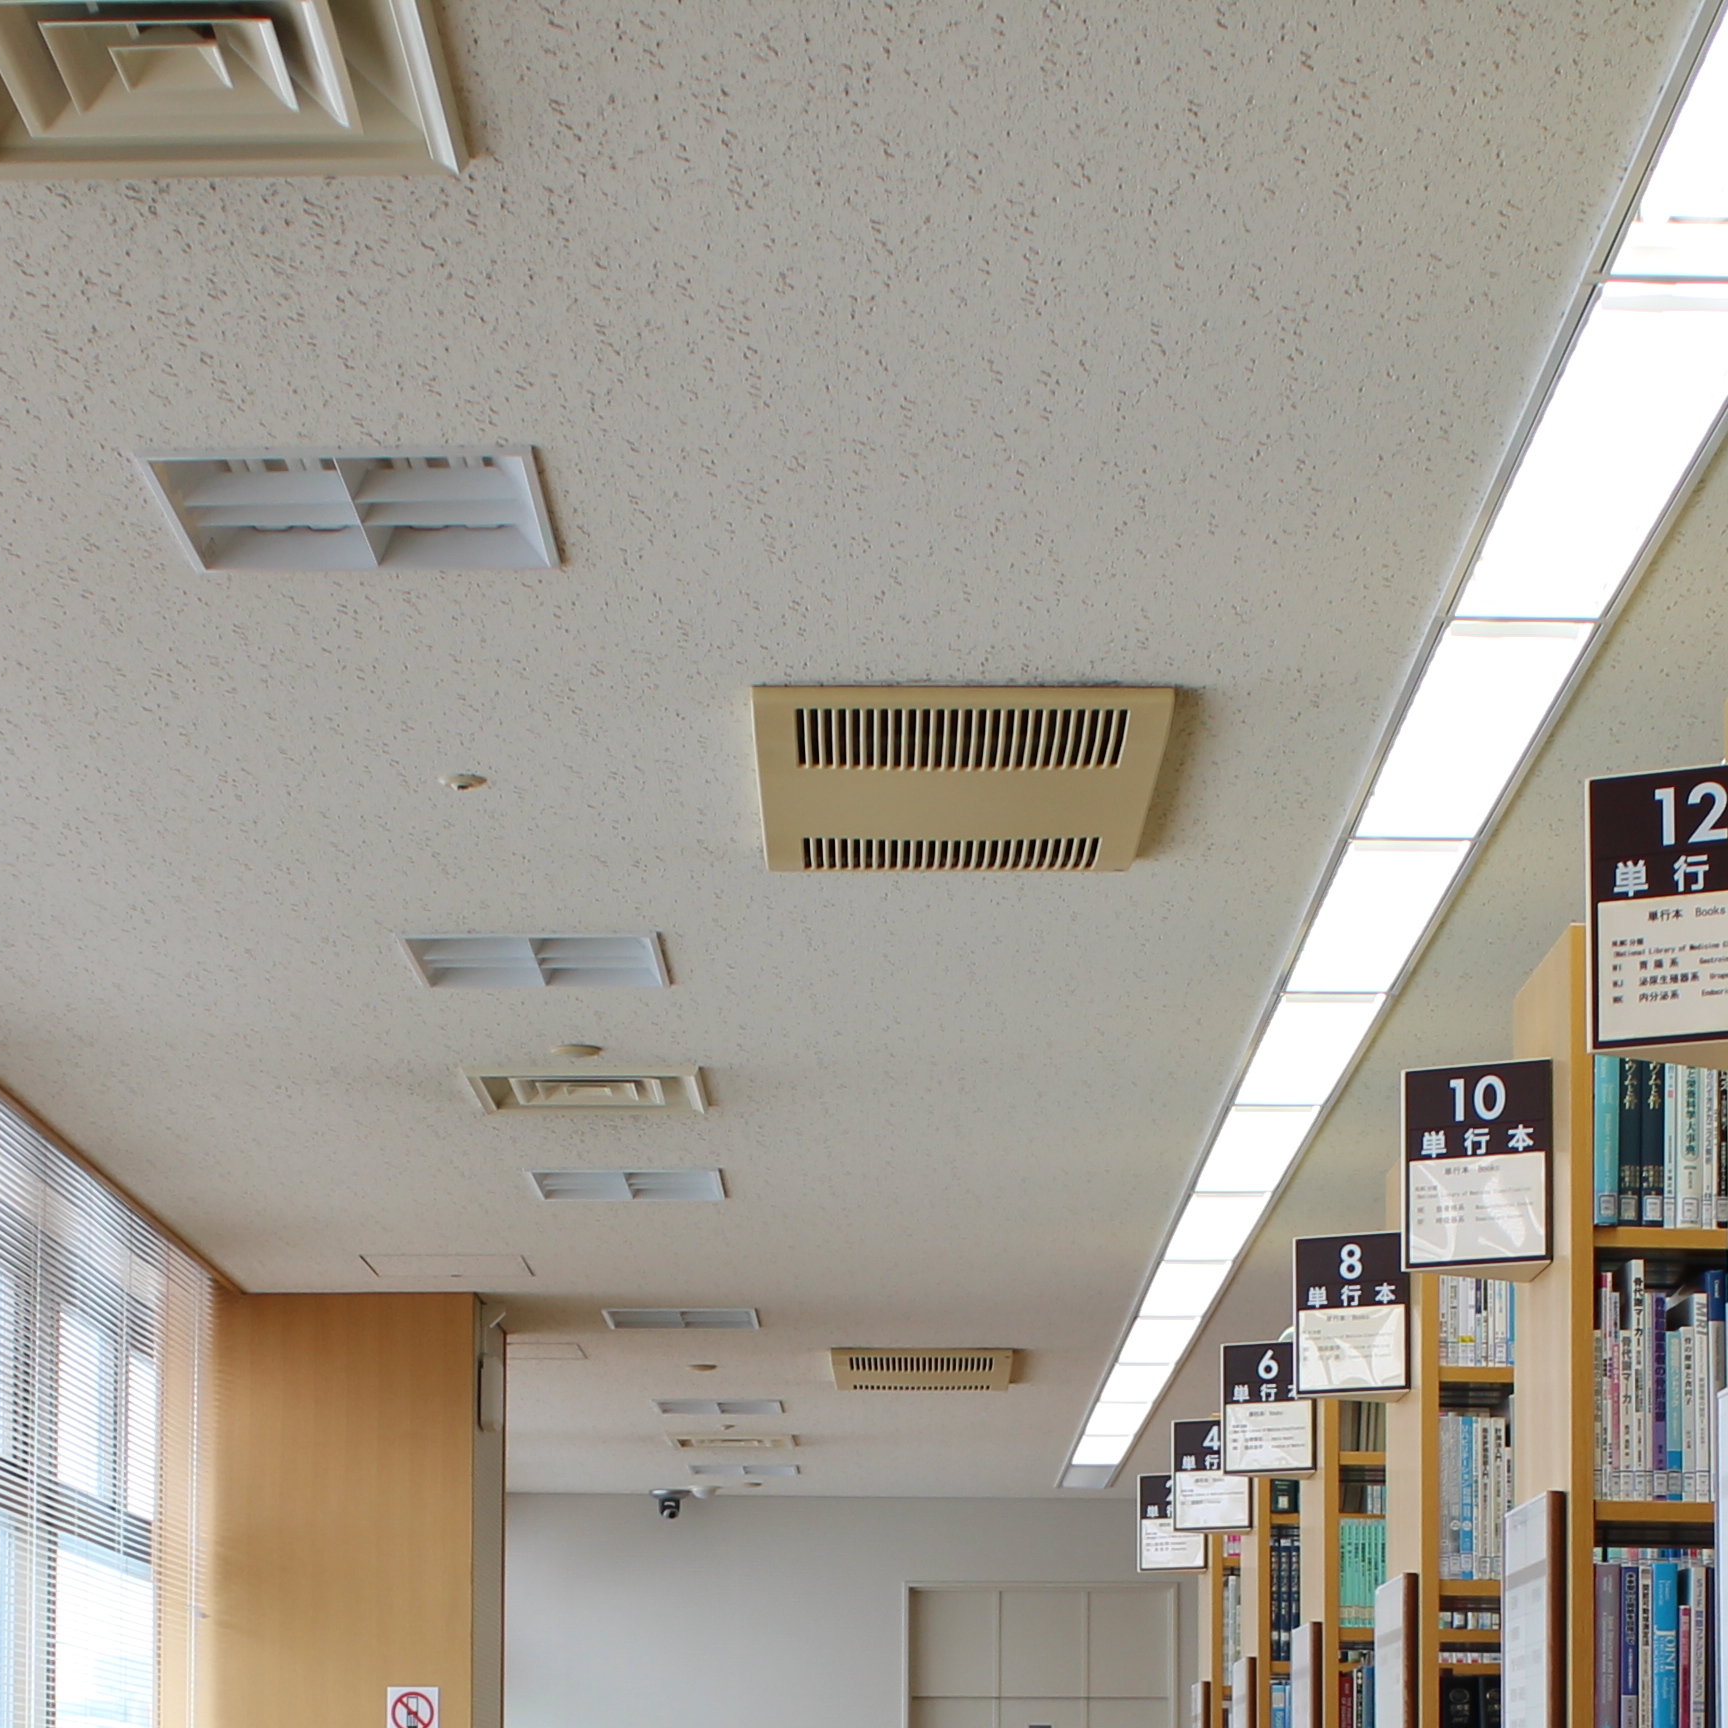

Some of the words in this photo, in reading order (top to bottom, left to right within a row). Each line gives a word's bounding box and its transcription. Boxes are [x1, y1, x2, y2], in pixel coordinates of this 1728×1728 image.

[1654, 781, 1728, 846] 12
[1695, 906, 1726, 918] Books
[1449, 1074, 1506, 1122] 10
[1421, 1124, 1534, 1158] 単行本
[1339, 1243, 1363, 1280] 8
[1307, 1282, 1396, 1308] 単行本
[1257, 1350, 1279, 1381] 6
[1232, 1384, 1296, 1403] 単行
[1202, 1425, 1220, 1451] 4
